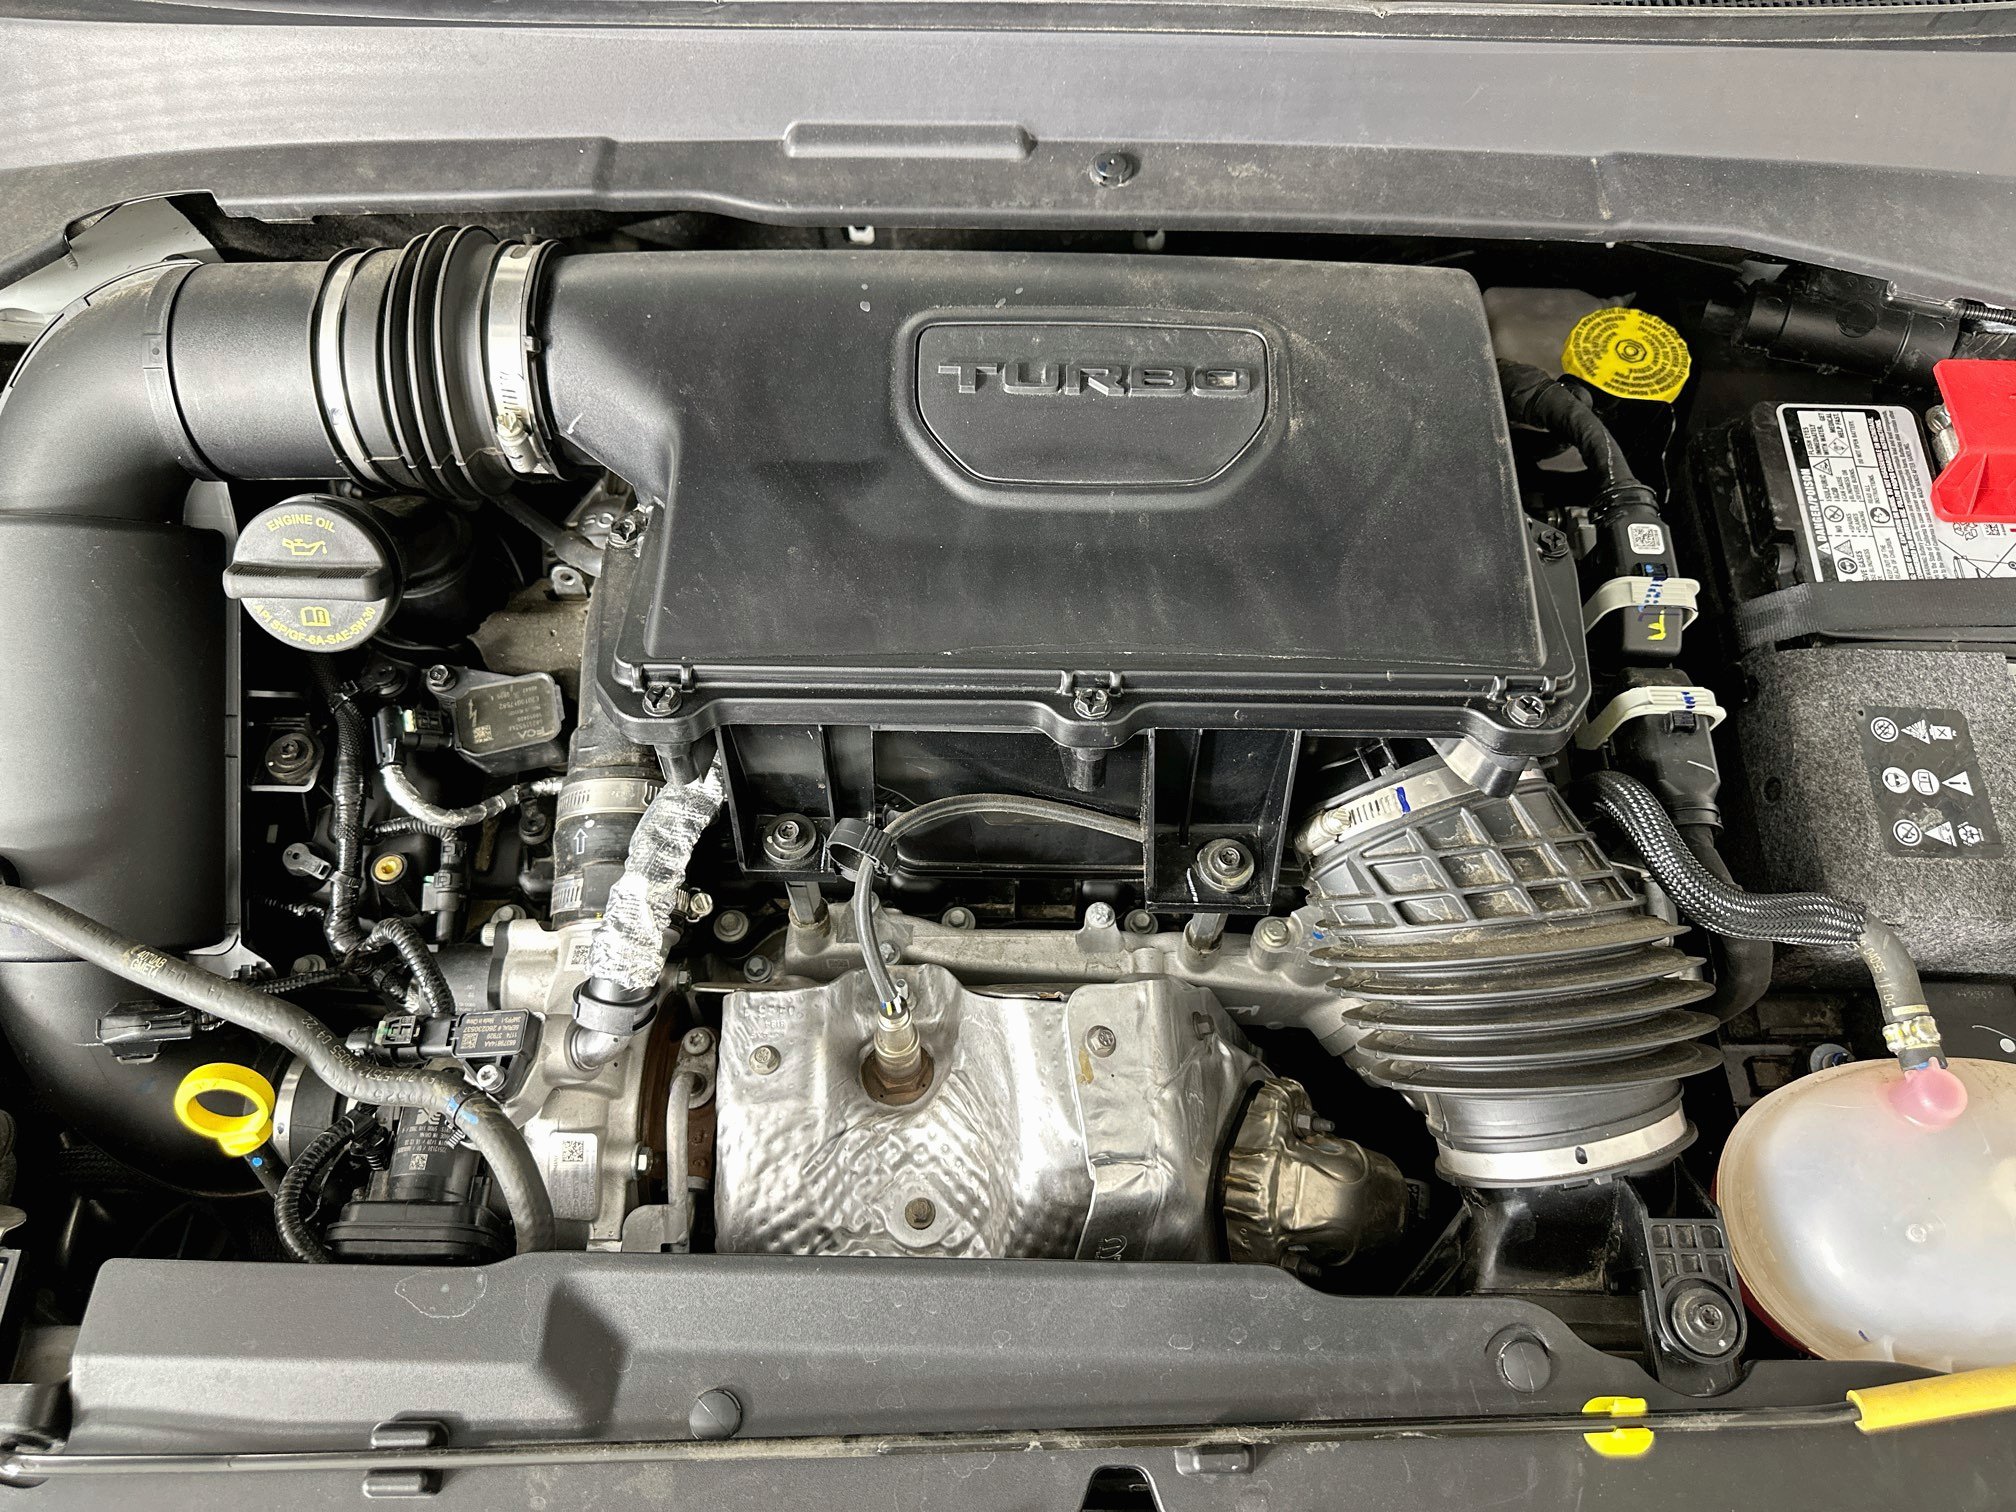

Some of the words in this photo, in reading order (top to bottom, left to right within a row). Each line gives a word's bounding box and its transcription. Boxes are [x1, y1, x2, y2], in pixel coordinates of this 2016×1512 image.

[938, 361, 1252, 398] TURBO
[1802, 427, 1810, 438] EYES
[1826, 413, 1836, 433] MEDICAL
[1836, 427, 1844, 438] HELP
[1809, 424, 1822, 455] IMMEDIATELY
[1852, 440, 1860, 449] OPEN
[1819, 475, 1832, 499] SULFURIC
[1831, 488, 1840, 499] ACID
[1799, 469, 1828, 541] DANGER/POISON
[266, 514, 313, 532] ENGINE
[316, 517, 335, 533] OIL
[254, 603, 270, 623] API
